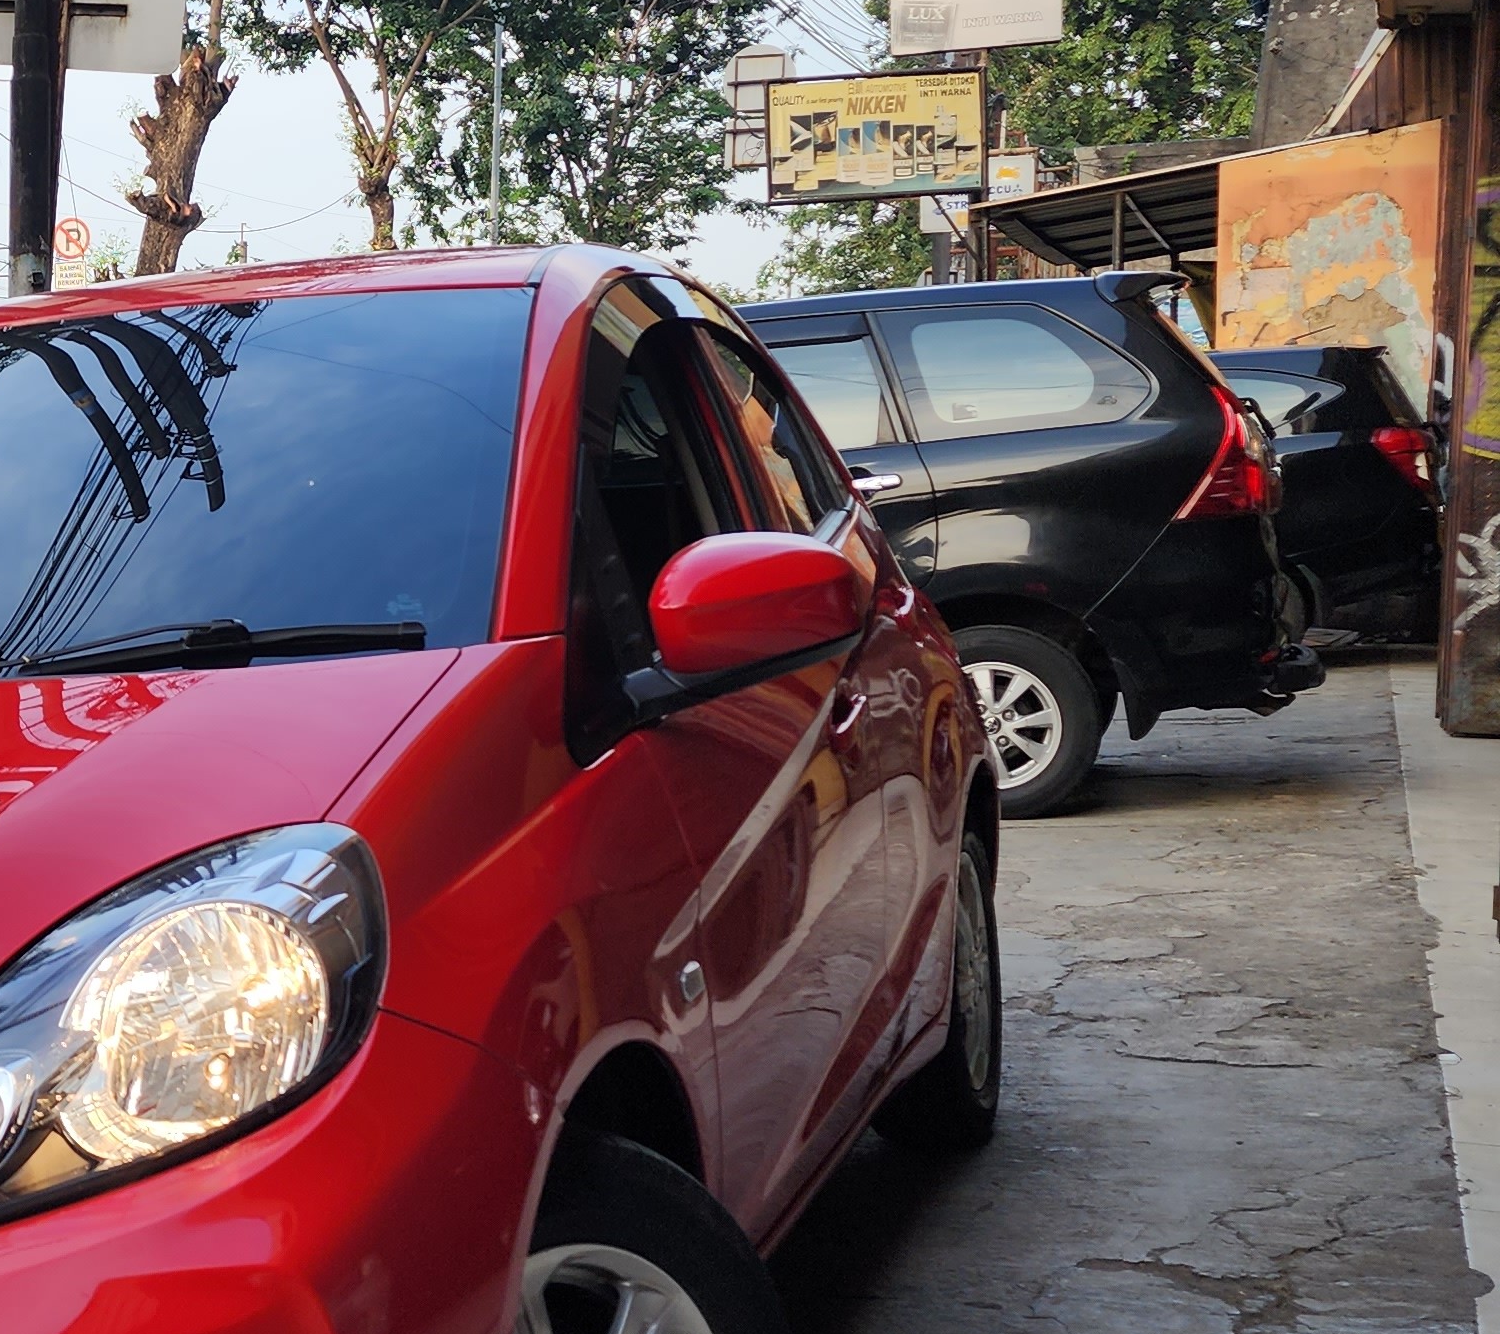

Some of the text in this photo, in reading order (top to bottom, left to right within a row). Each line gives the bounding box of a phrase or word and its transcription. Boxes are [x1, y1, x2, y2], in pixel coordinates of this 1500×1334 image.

[907, 5, 946, 20] LUX
[962, 11, 1043, 28] INTI WARNA
[920, 87, 972, 97] INTI WARNA
[772, 95, 805, 107] QUALITY
[846, 94, 908, 115] NIKKEN
